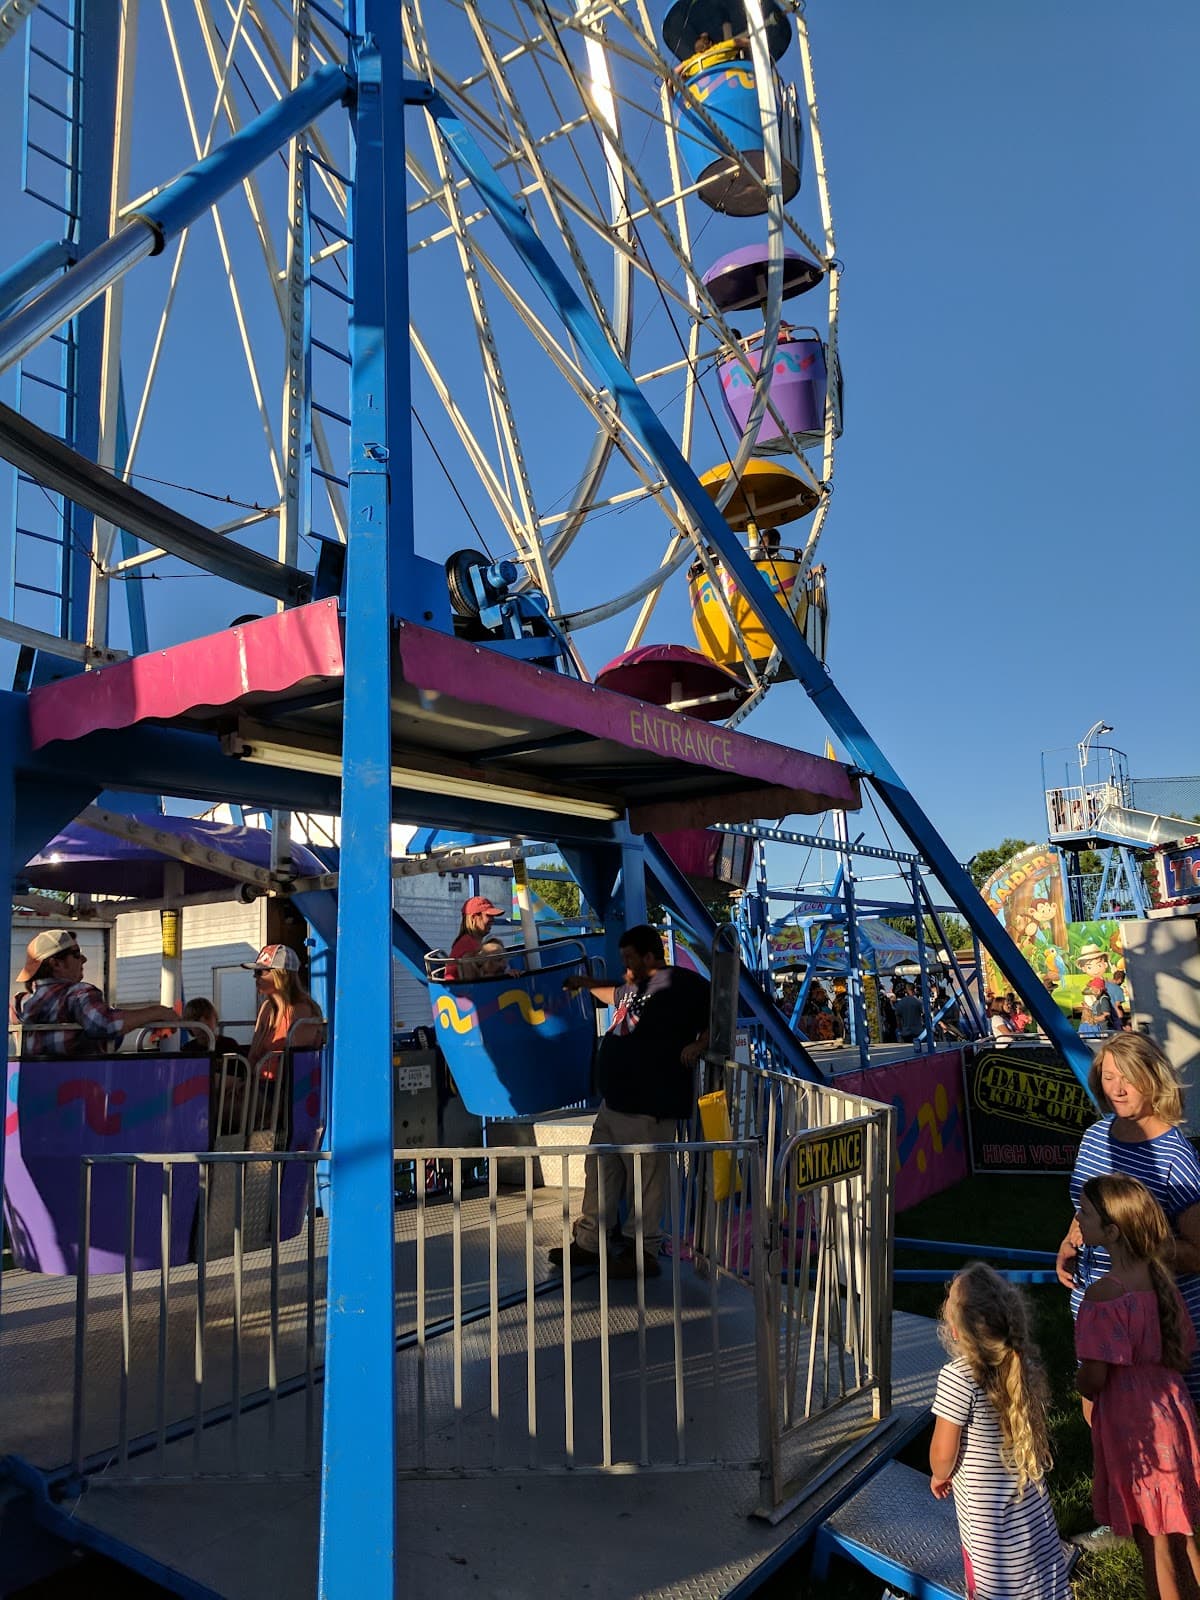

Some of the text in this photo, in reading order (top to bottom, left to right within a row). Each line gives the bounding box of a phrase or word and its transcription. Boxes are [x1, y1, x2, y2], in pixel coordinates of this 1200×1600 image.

[629, 710, 735, 768] ENTRANCE
[989, 1086, 1086, 1124] KEEP OUT
[799, 1133, 861, 1185] ENTRANCE
[982, 1143, 1079, 1165] HIGH VOLT
